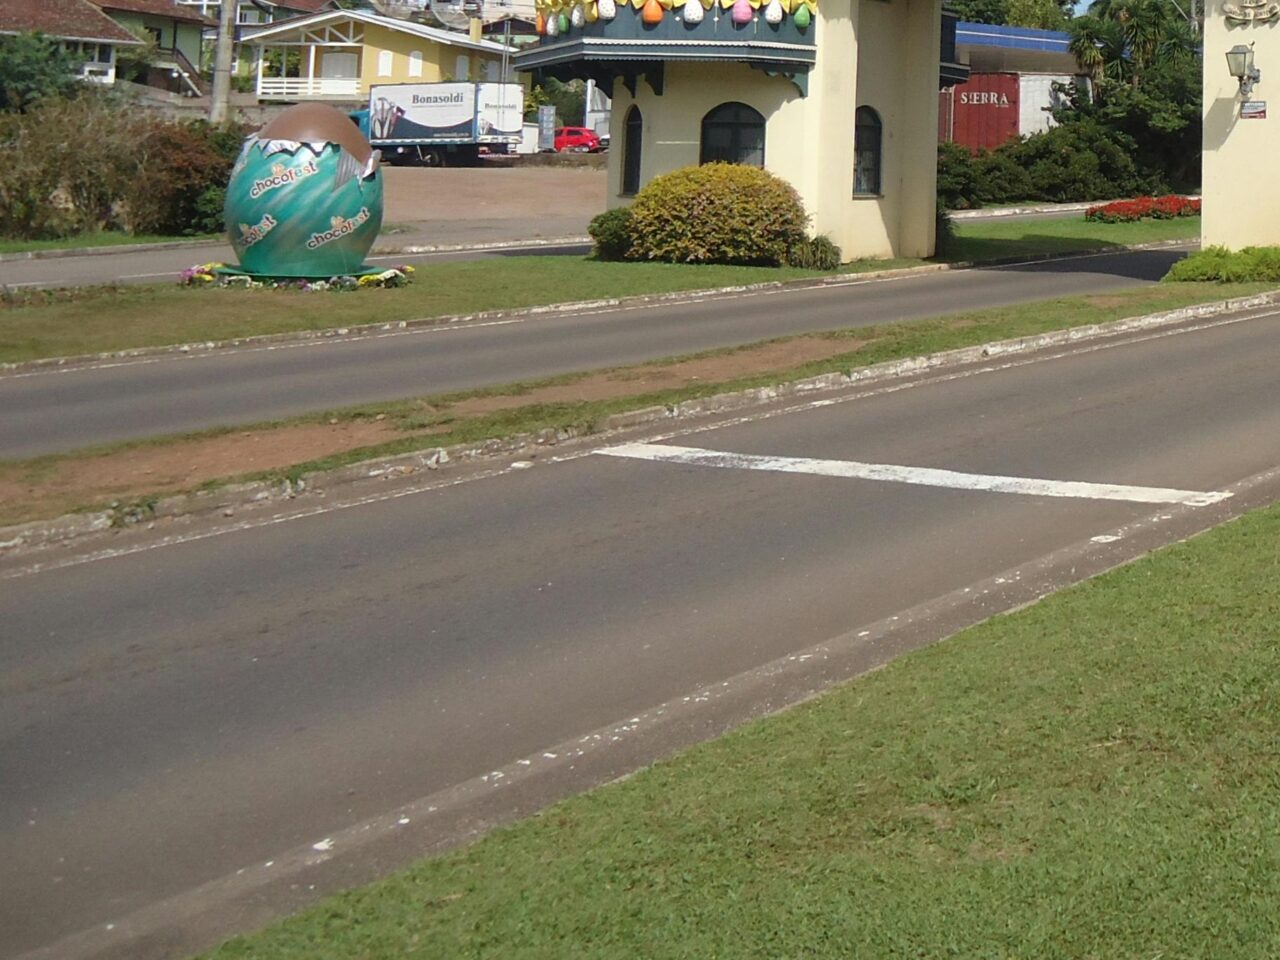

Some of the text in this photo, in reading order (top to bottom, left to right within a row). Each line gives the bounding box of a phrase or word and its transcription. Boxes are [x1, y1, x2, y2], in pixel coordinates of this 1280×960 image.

[411, 92, 464, 104] Bonasoldi
[250, 160, 318, 197] chocofest
[306, 208, 369, 249] chocofest
